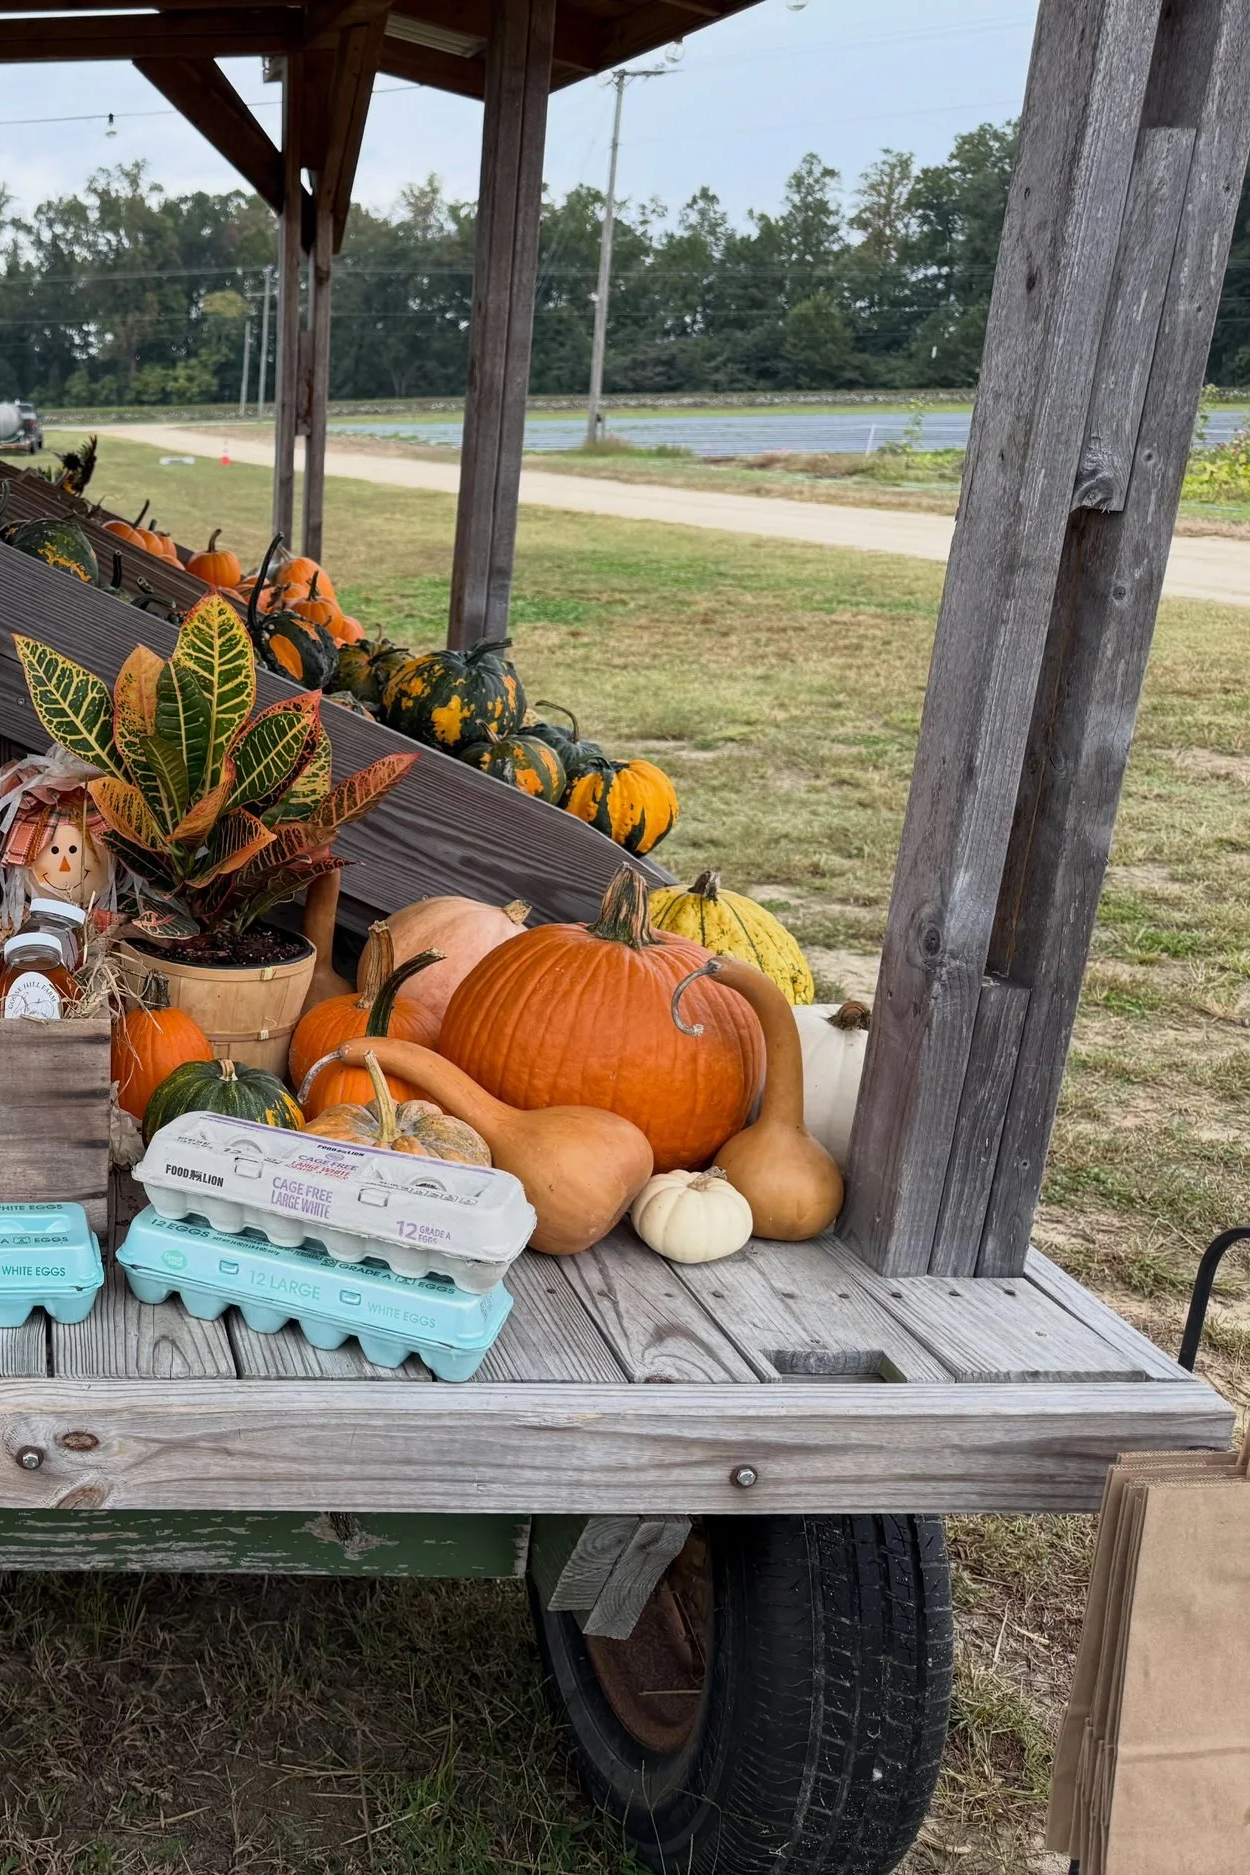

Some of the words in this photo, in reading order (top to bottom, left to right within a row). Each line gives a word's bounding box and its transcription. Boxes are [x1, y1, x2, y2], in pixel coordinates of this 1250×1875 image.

[41, 984, 57, 1002] FARM
[298, 1154, 330, 1165] CAGE
[330, 1162, 359, 1172] FREE
[165, 1164, 189, 1179] FOOD
[203, 1173, 224, 1188] LION
[272, 1176, 303, 1196] CAGE
[305, 1187, 334, 1204] FREE
[270, 1190, 300, 1211] LARGE
[301, 1198, 331, 1219] WHITE
[151, 1218, 167, 1231] 12
[167, 1221, 210, 1238] EGGS
[396, 1220, 418, 1241] 12
[419, 1225, 445, 1239] GRADE
[445, 1231, 451, 1241] A
[34, 1236, 69, 1244] EGGS
[418, 1234, 438, 1245] EGGS
[1, 1265, 33, 1277] WHITE
[35, 1266, 66, 1277] EGGS
[338, 1262, 380, 1278] GRADE
[378, 1273, 392, 1281] A
[418, 1282, 456, 1295] EGGS
[250, 1270, 267, 1285] 12
[270, 1272, 322, 1300] LARGE
[367, 1301, 401, 1319] WHITE
[403, 1311, 436, 1329] EGGS
